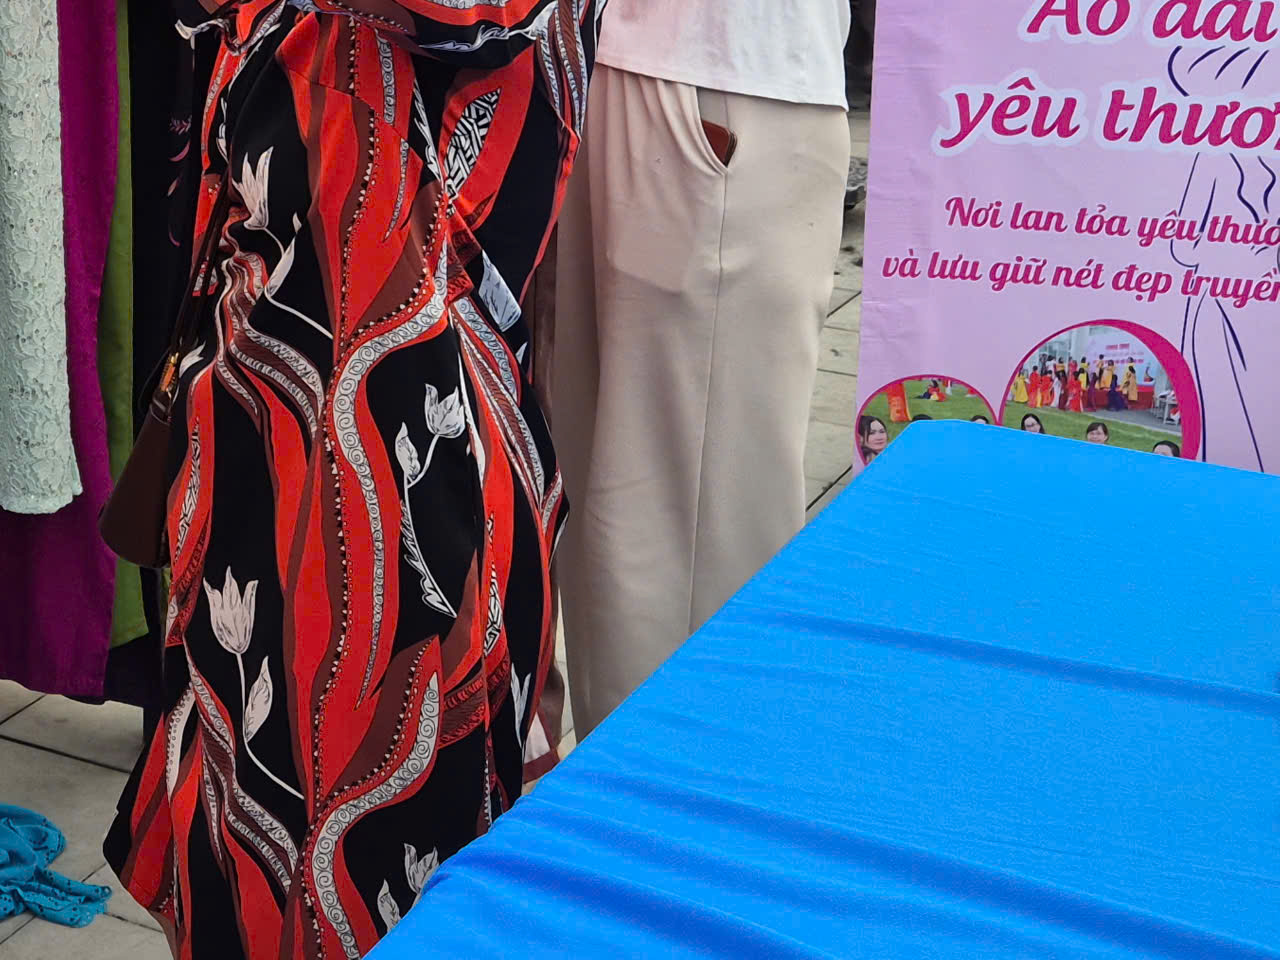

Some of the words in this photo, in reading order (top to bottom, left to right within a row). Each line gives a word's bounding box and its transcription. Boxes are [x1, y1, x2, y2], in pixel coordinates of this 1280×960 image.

[940, 77, 1080, 148] yêu
[1103, 86, 1280, 150] thươ
[945, 196, 1004, 228] Nơi
[1010, 202, 1068, 233] lan
[1075, 204, 1131, 236] tỏa
[1137, 210, 1200, 247] yêu
[882, 248, 921, 279] và
[927, 251, 982, 281] lưu
[989, 255, 1047, 291] giữ
[1051, 258, 1105, 289] nét
[1111, 264, 1173, 302] đẹp
